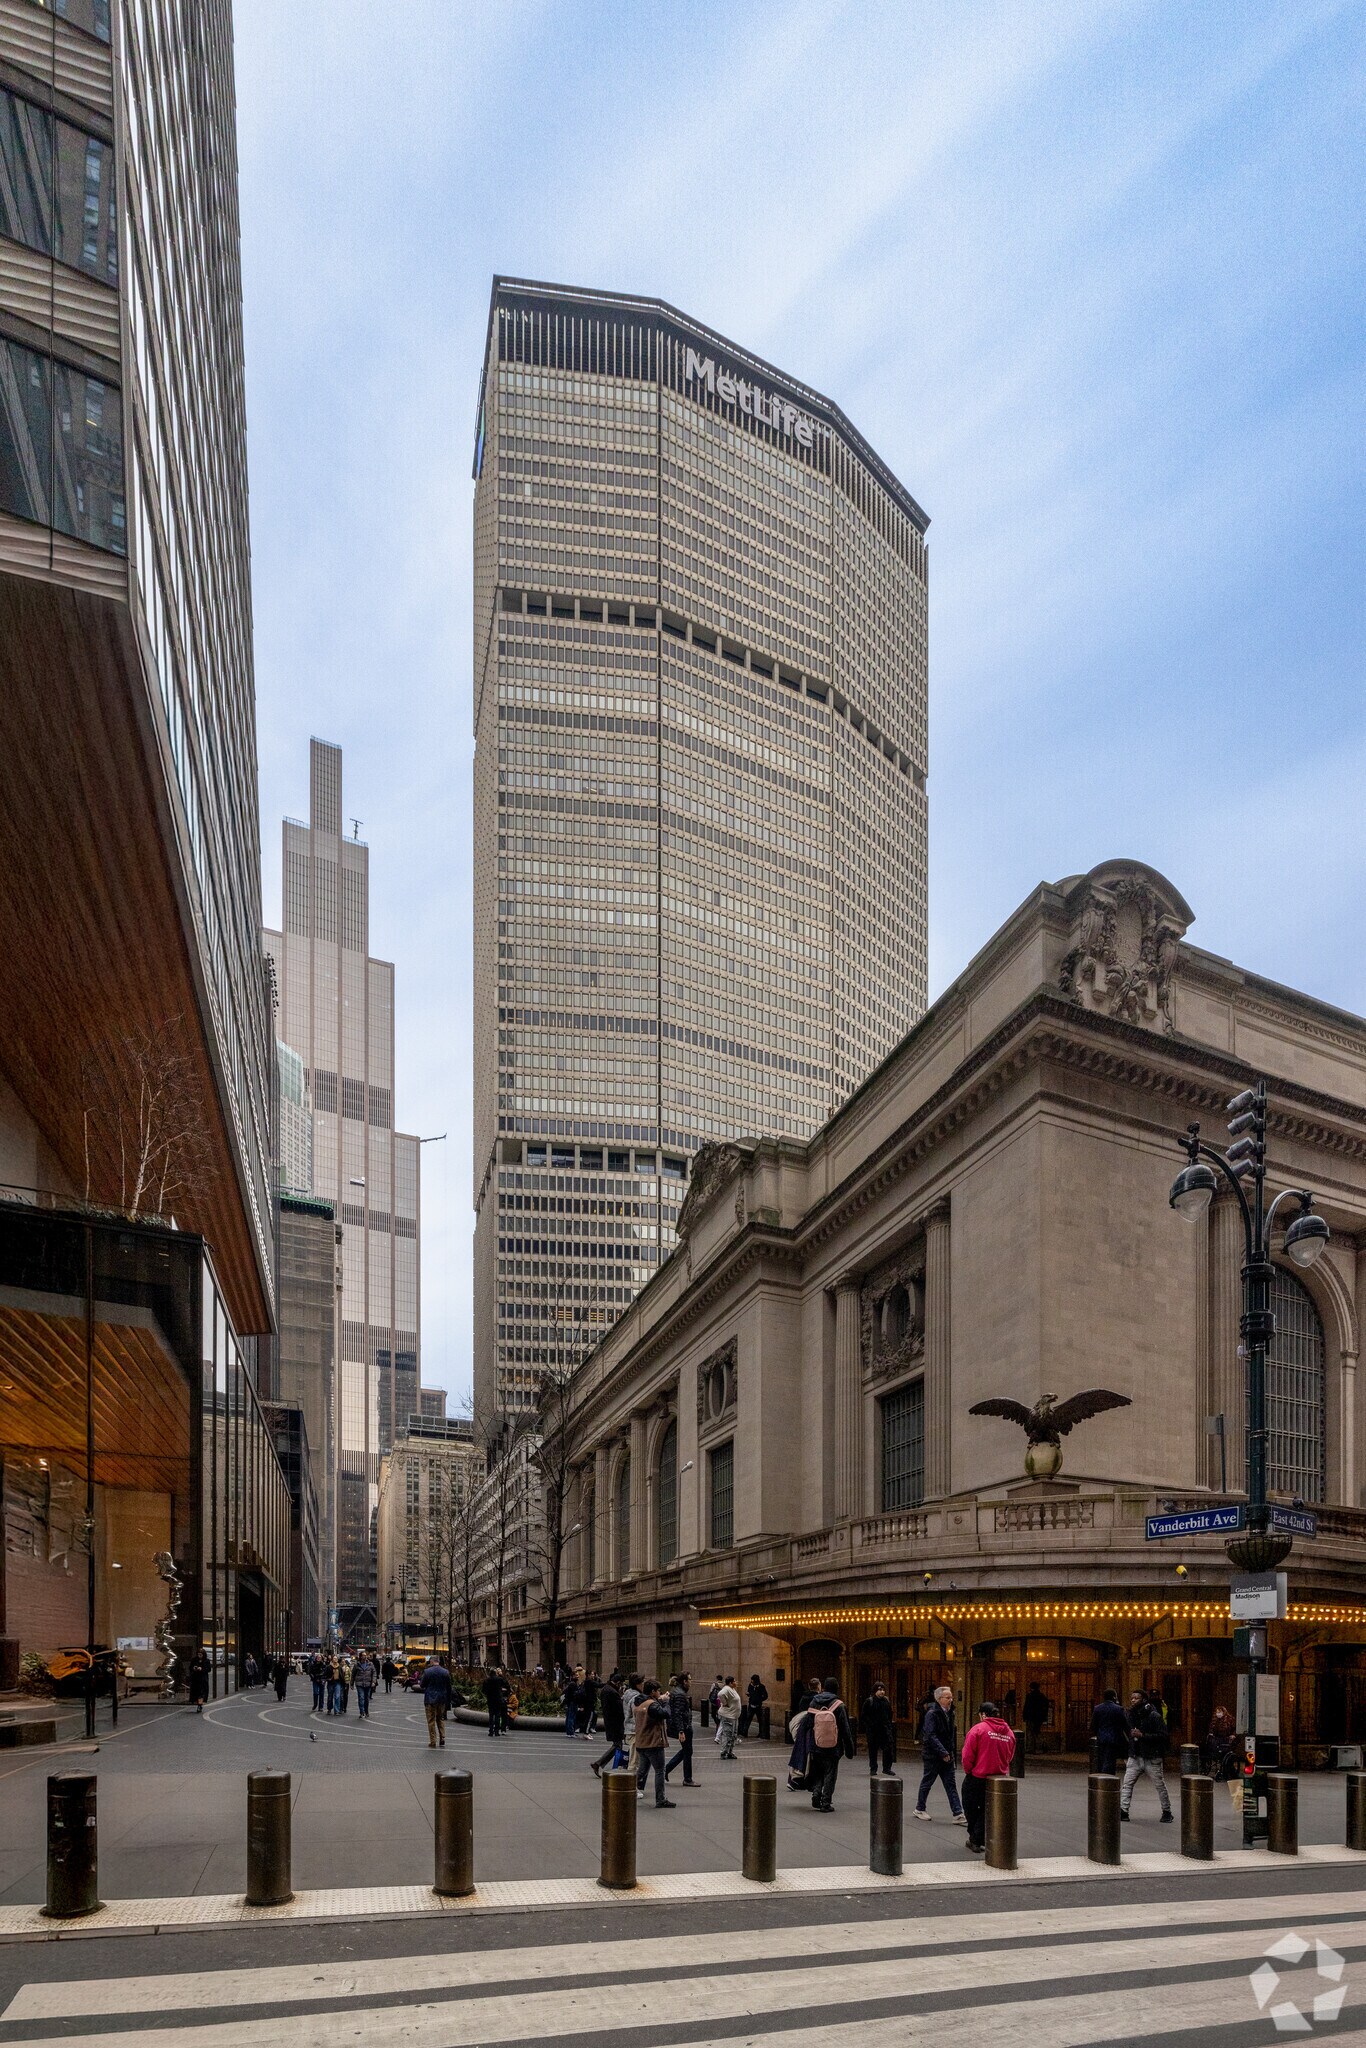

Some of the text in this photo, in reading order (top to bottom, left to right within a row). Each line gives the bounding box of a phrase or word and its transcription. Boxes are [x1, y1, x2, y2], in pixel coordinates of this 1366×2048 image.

[685, 346, 813, 447] MetLife
[1149, 1513, 1237, 1534] Vanderbilt Ave
[1273, 1510, 1314, 1532] East 42nd St
[1251, 1584, 1272, 1592] Central
